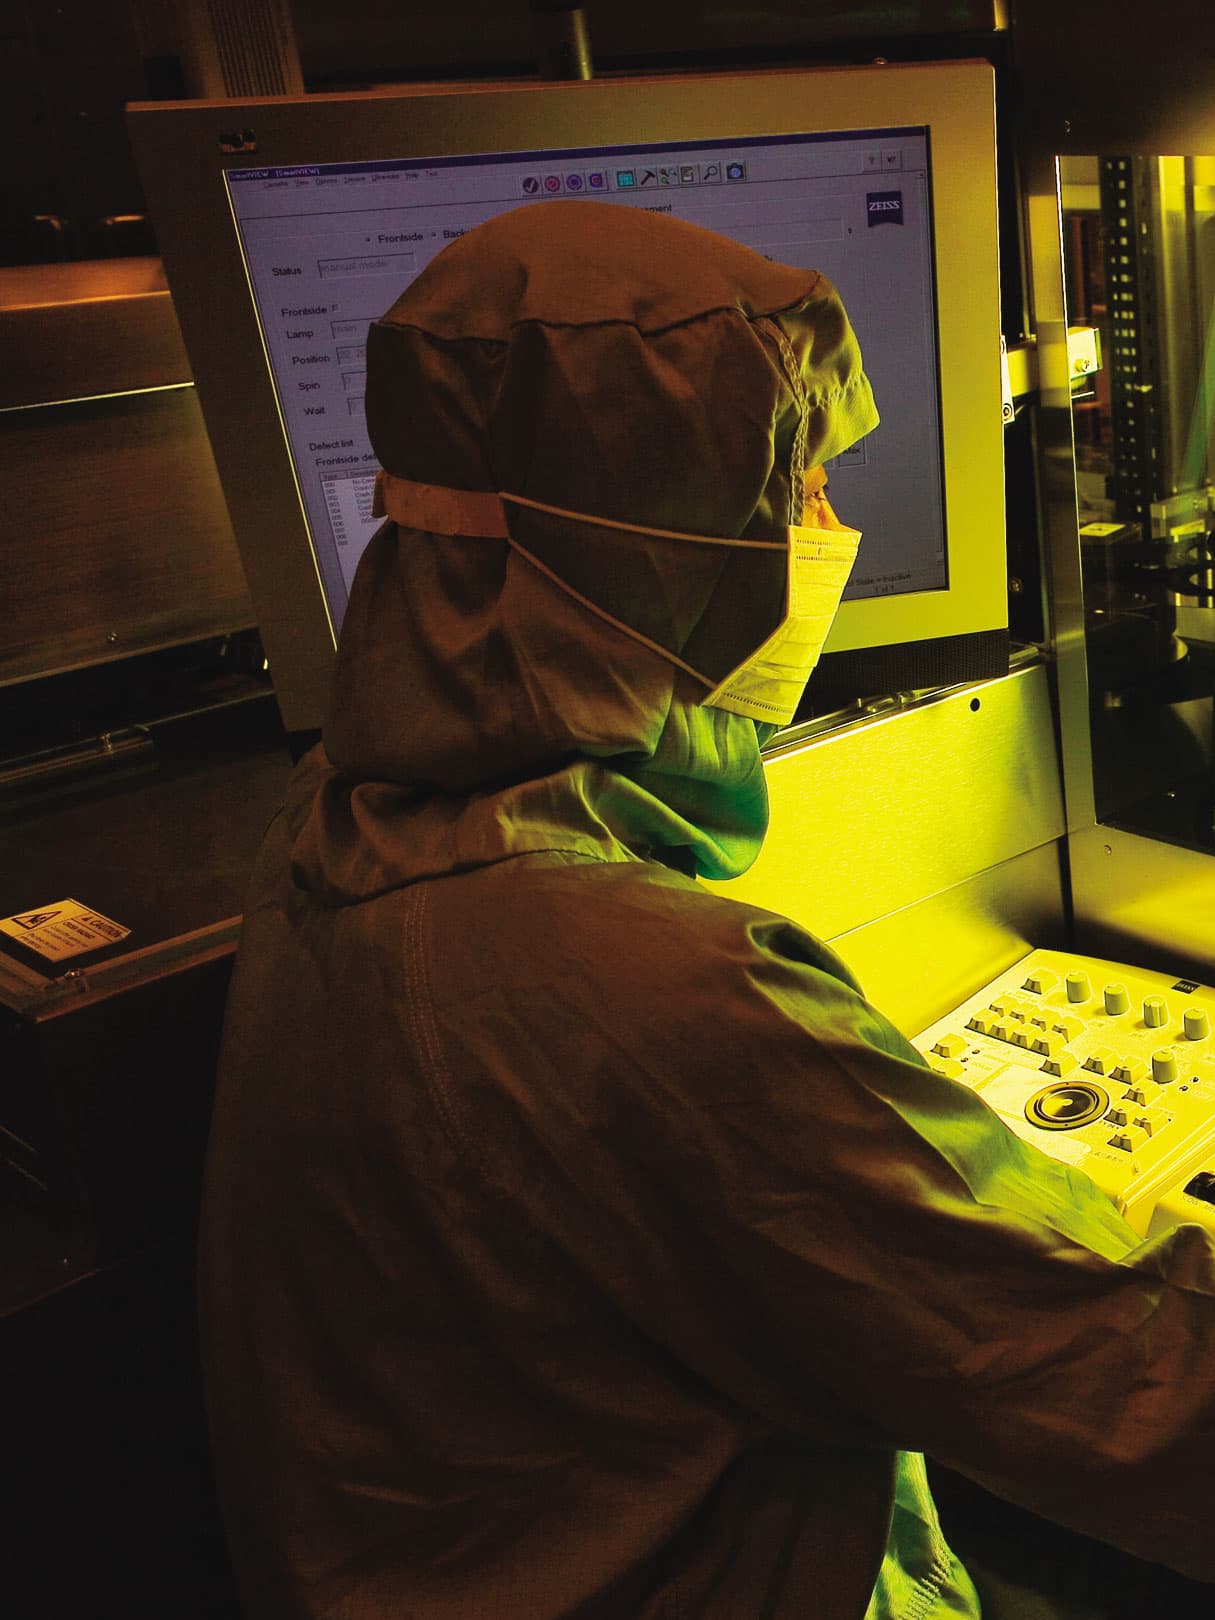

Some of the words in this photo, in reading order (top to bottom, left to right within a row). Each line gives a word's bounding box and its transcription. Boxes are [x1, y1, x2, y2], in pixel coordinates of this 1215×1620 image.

[868, 200, 900, 212] ZEISS
[377, 231, 423, 244] Frontside
[271, 265, 302, 277] Status
[281, 305, 328, 318] Frontside
[286, 329, 314, 341] Lamp
[292, 354, 331, 366] Position
[298, 381, 321, 393] Spin
[309, 441, 340, 452] Defect
[315, 455, 359, 467] Frontside
